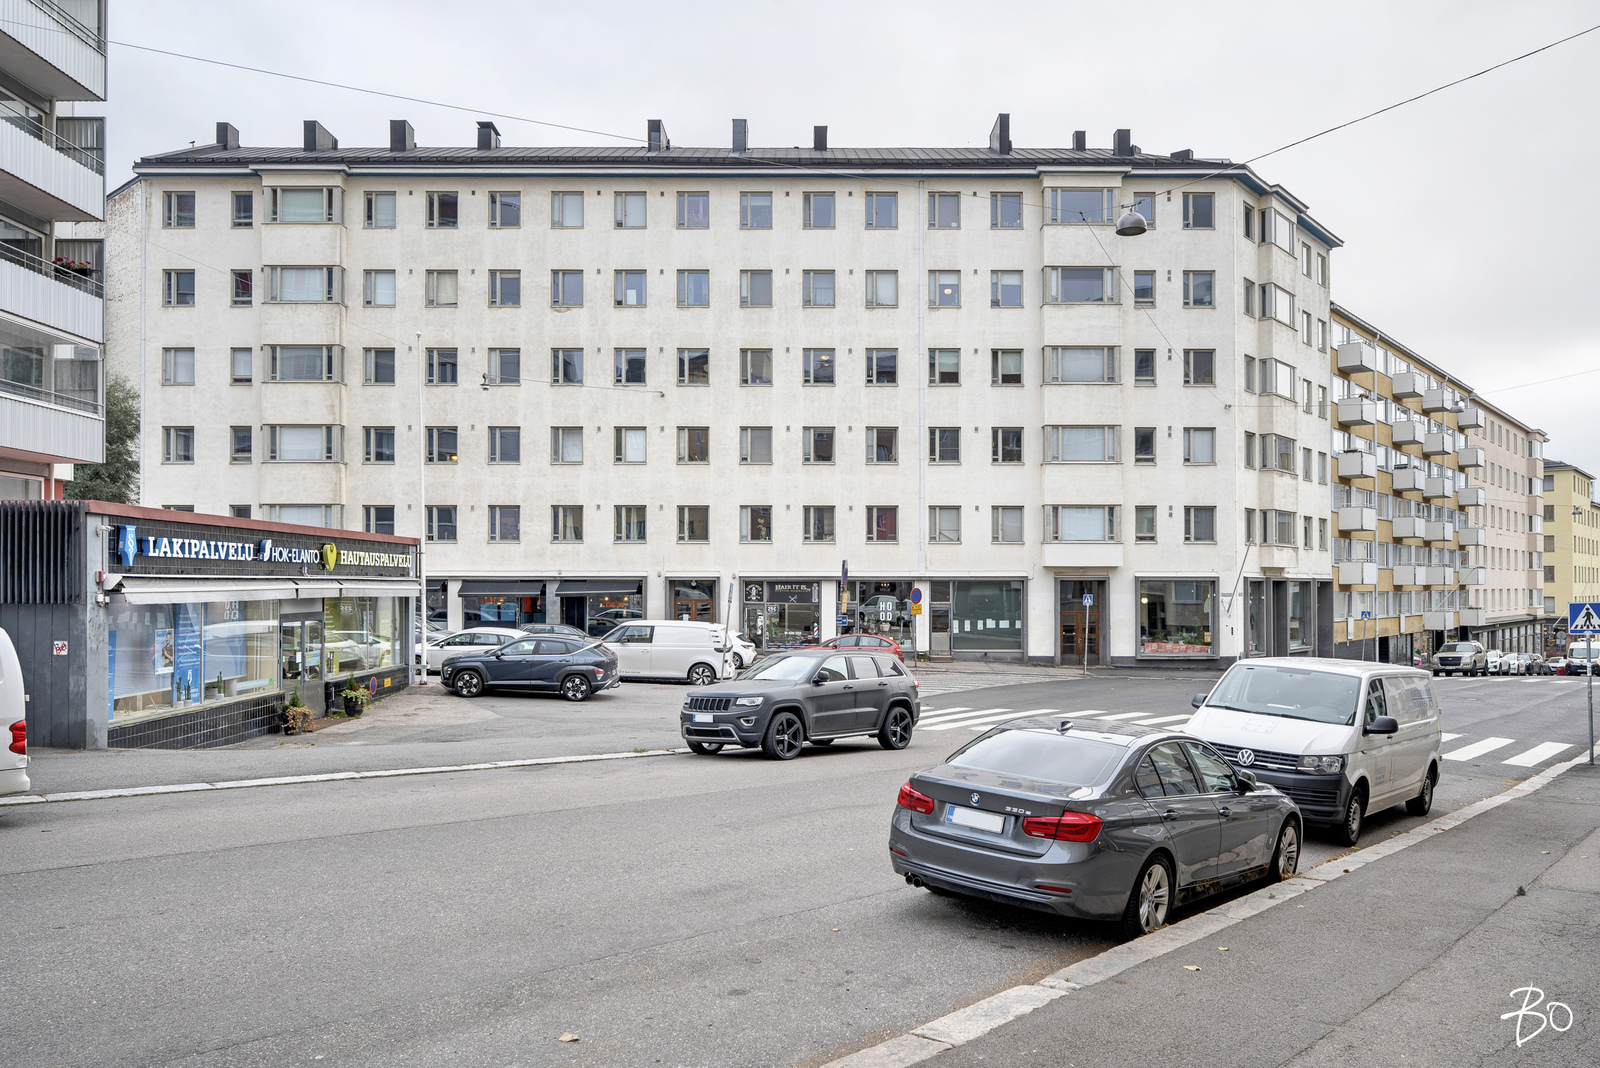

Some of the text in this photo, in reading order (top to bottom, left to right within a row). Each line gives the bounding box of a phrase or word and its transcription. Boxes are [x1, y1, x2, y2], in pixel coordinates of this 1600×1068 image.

[148, 536, 254, 561] LAKIPALVELU
[271, 547, 320, 564] HOK-ELANTO
[340, 550, 412, 568] HAUTAUSPALVELU
[880, 601, 892, 611] HO
[880, 612, 892, 621] OD
